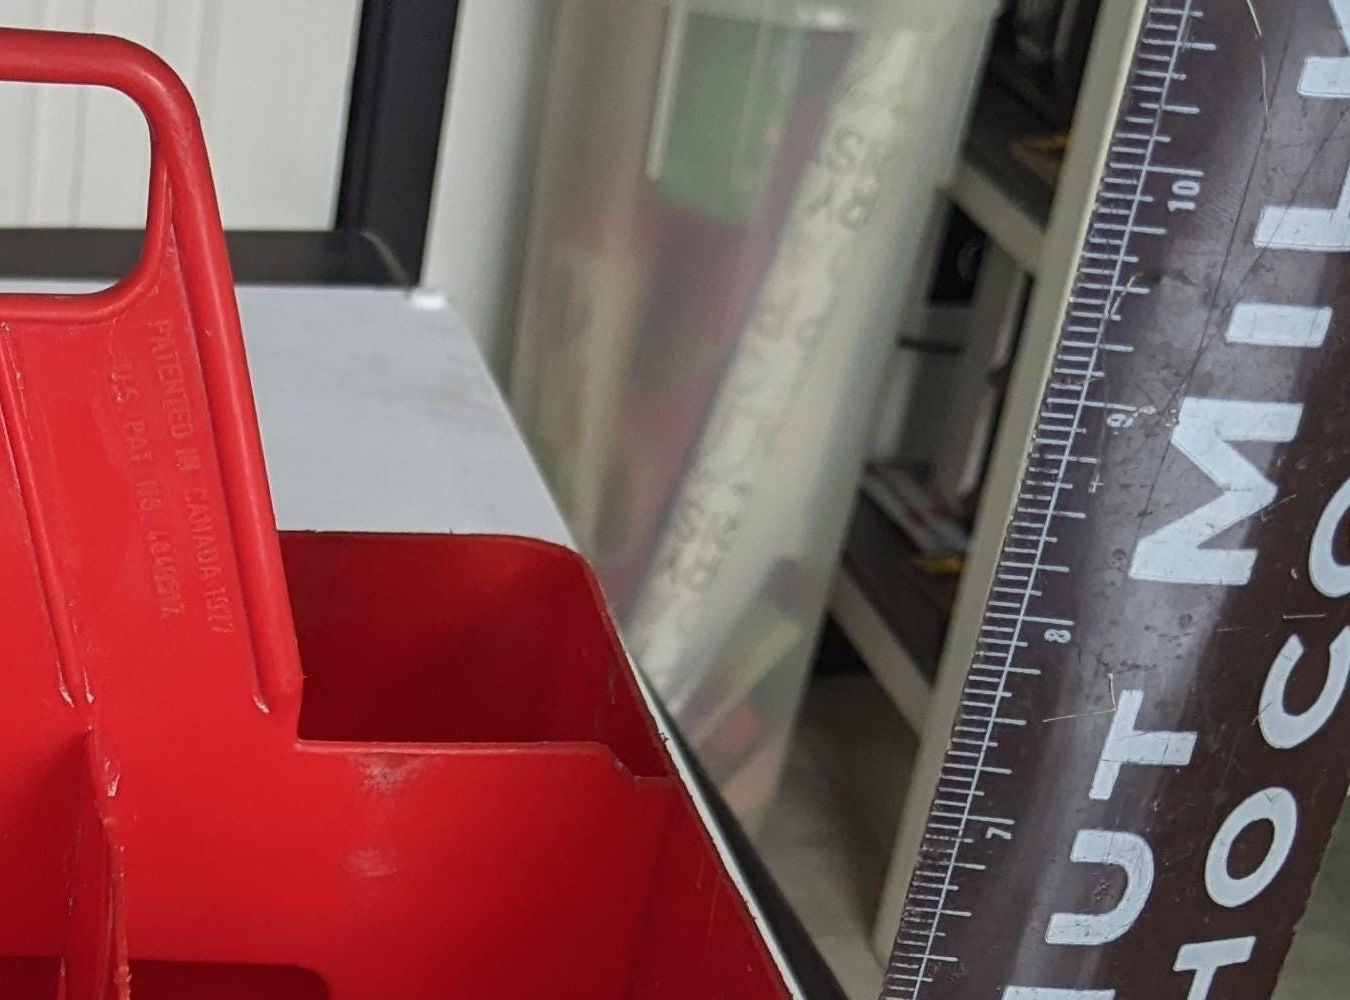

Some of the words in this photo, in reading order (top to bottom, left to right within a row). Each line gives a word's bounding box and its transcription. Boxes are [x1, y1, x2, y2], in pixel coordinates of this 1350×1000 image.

[1166, 179, 1201, 212] 10
[151, 318, 193, 438] PATENTED
[1105, 412, 1135, 428] 9
[176, 449, 201, 473] IN
[184, 487, 223, 579] CANADA
[1043, 628, 1072, 643] 8
[985, 826, 1013, 840] 7
